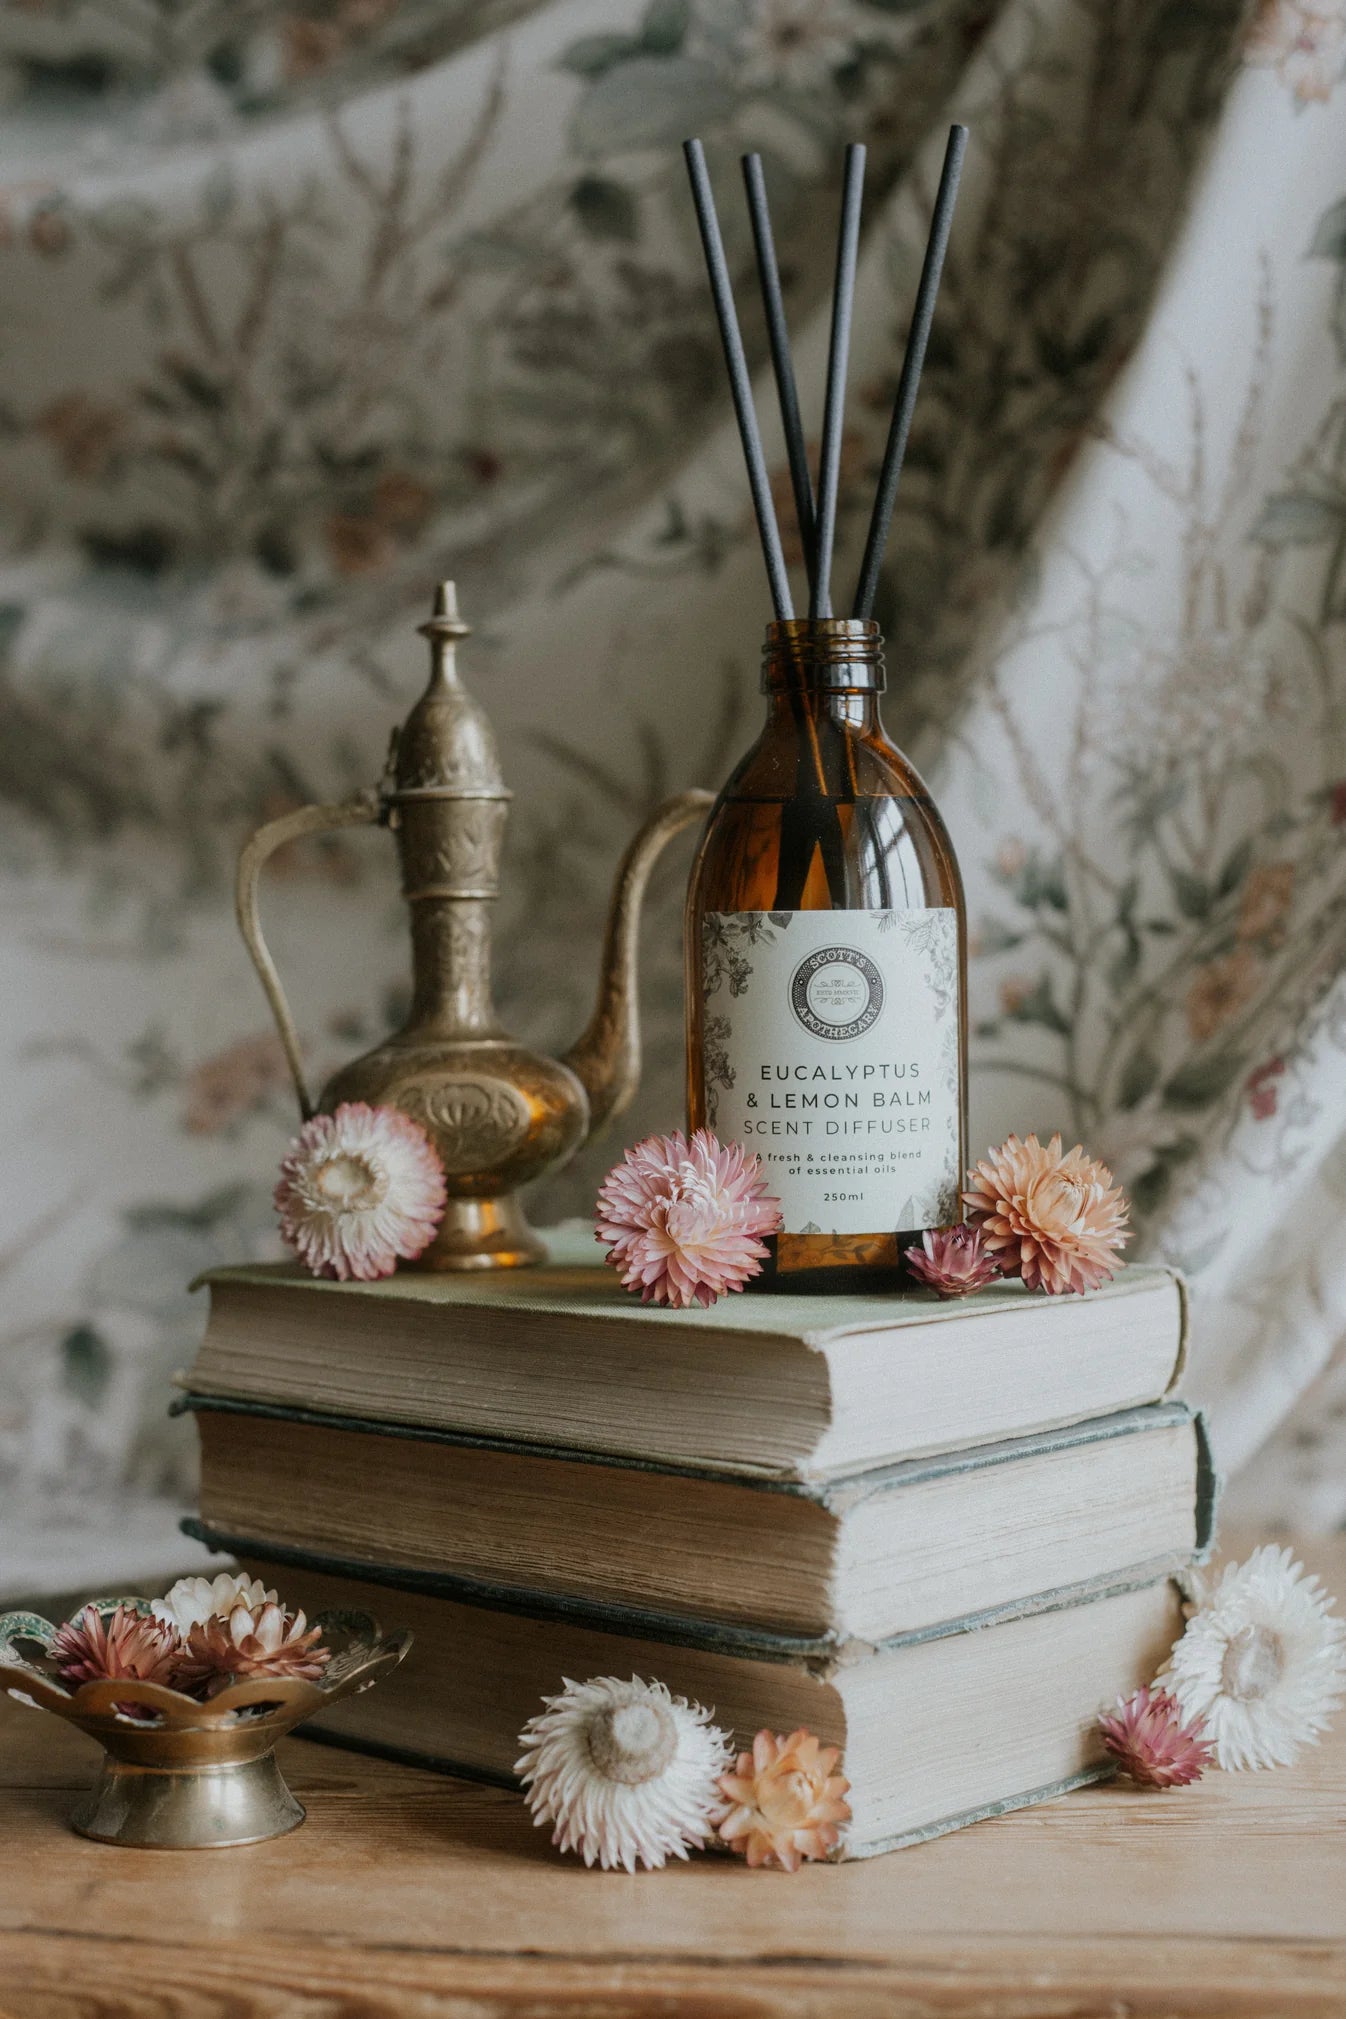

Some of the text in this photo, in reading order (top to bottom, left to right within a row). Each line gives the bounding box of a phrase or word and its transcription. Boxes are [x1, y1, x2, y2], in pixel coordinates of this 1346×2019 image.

[810, 950, 867, 969] SCOTT'S
[797, 1006, 878, 1037] APOTHECARY
[761, 1063, 920, 1080] EUCALYPTUS
[746, 1090, 931, 1108] & LEMON BALM
[744, 1118, 930, 1135] SCENT DIFFUSER
[768, 1153, 800, 1162] fresh
[806, 1153, 814, 1162] &
[820, 1152, 884, 1163] cleansing
[890, 1151, 922, 1160] blend
[788, 1165, 897, 1175] of essential oils
[823, 1193, 864, 1202] 250ml
